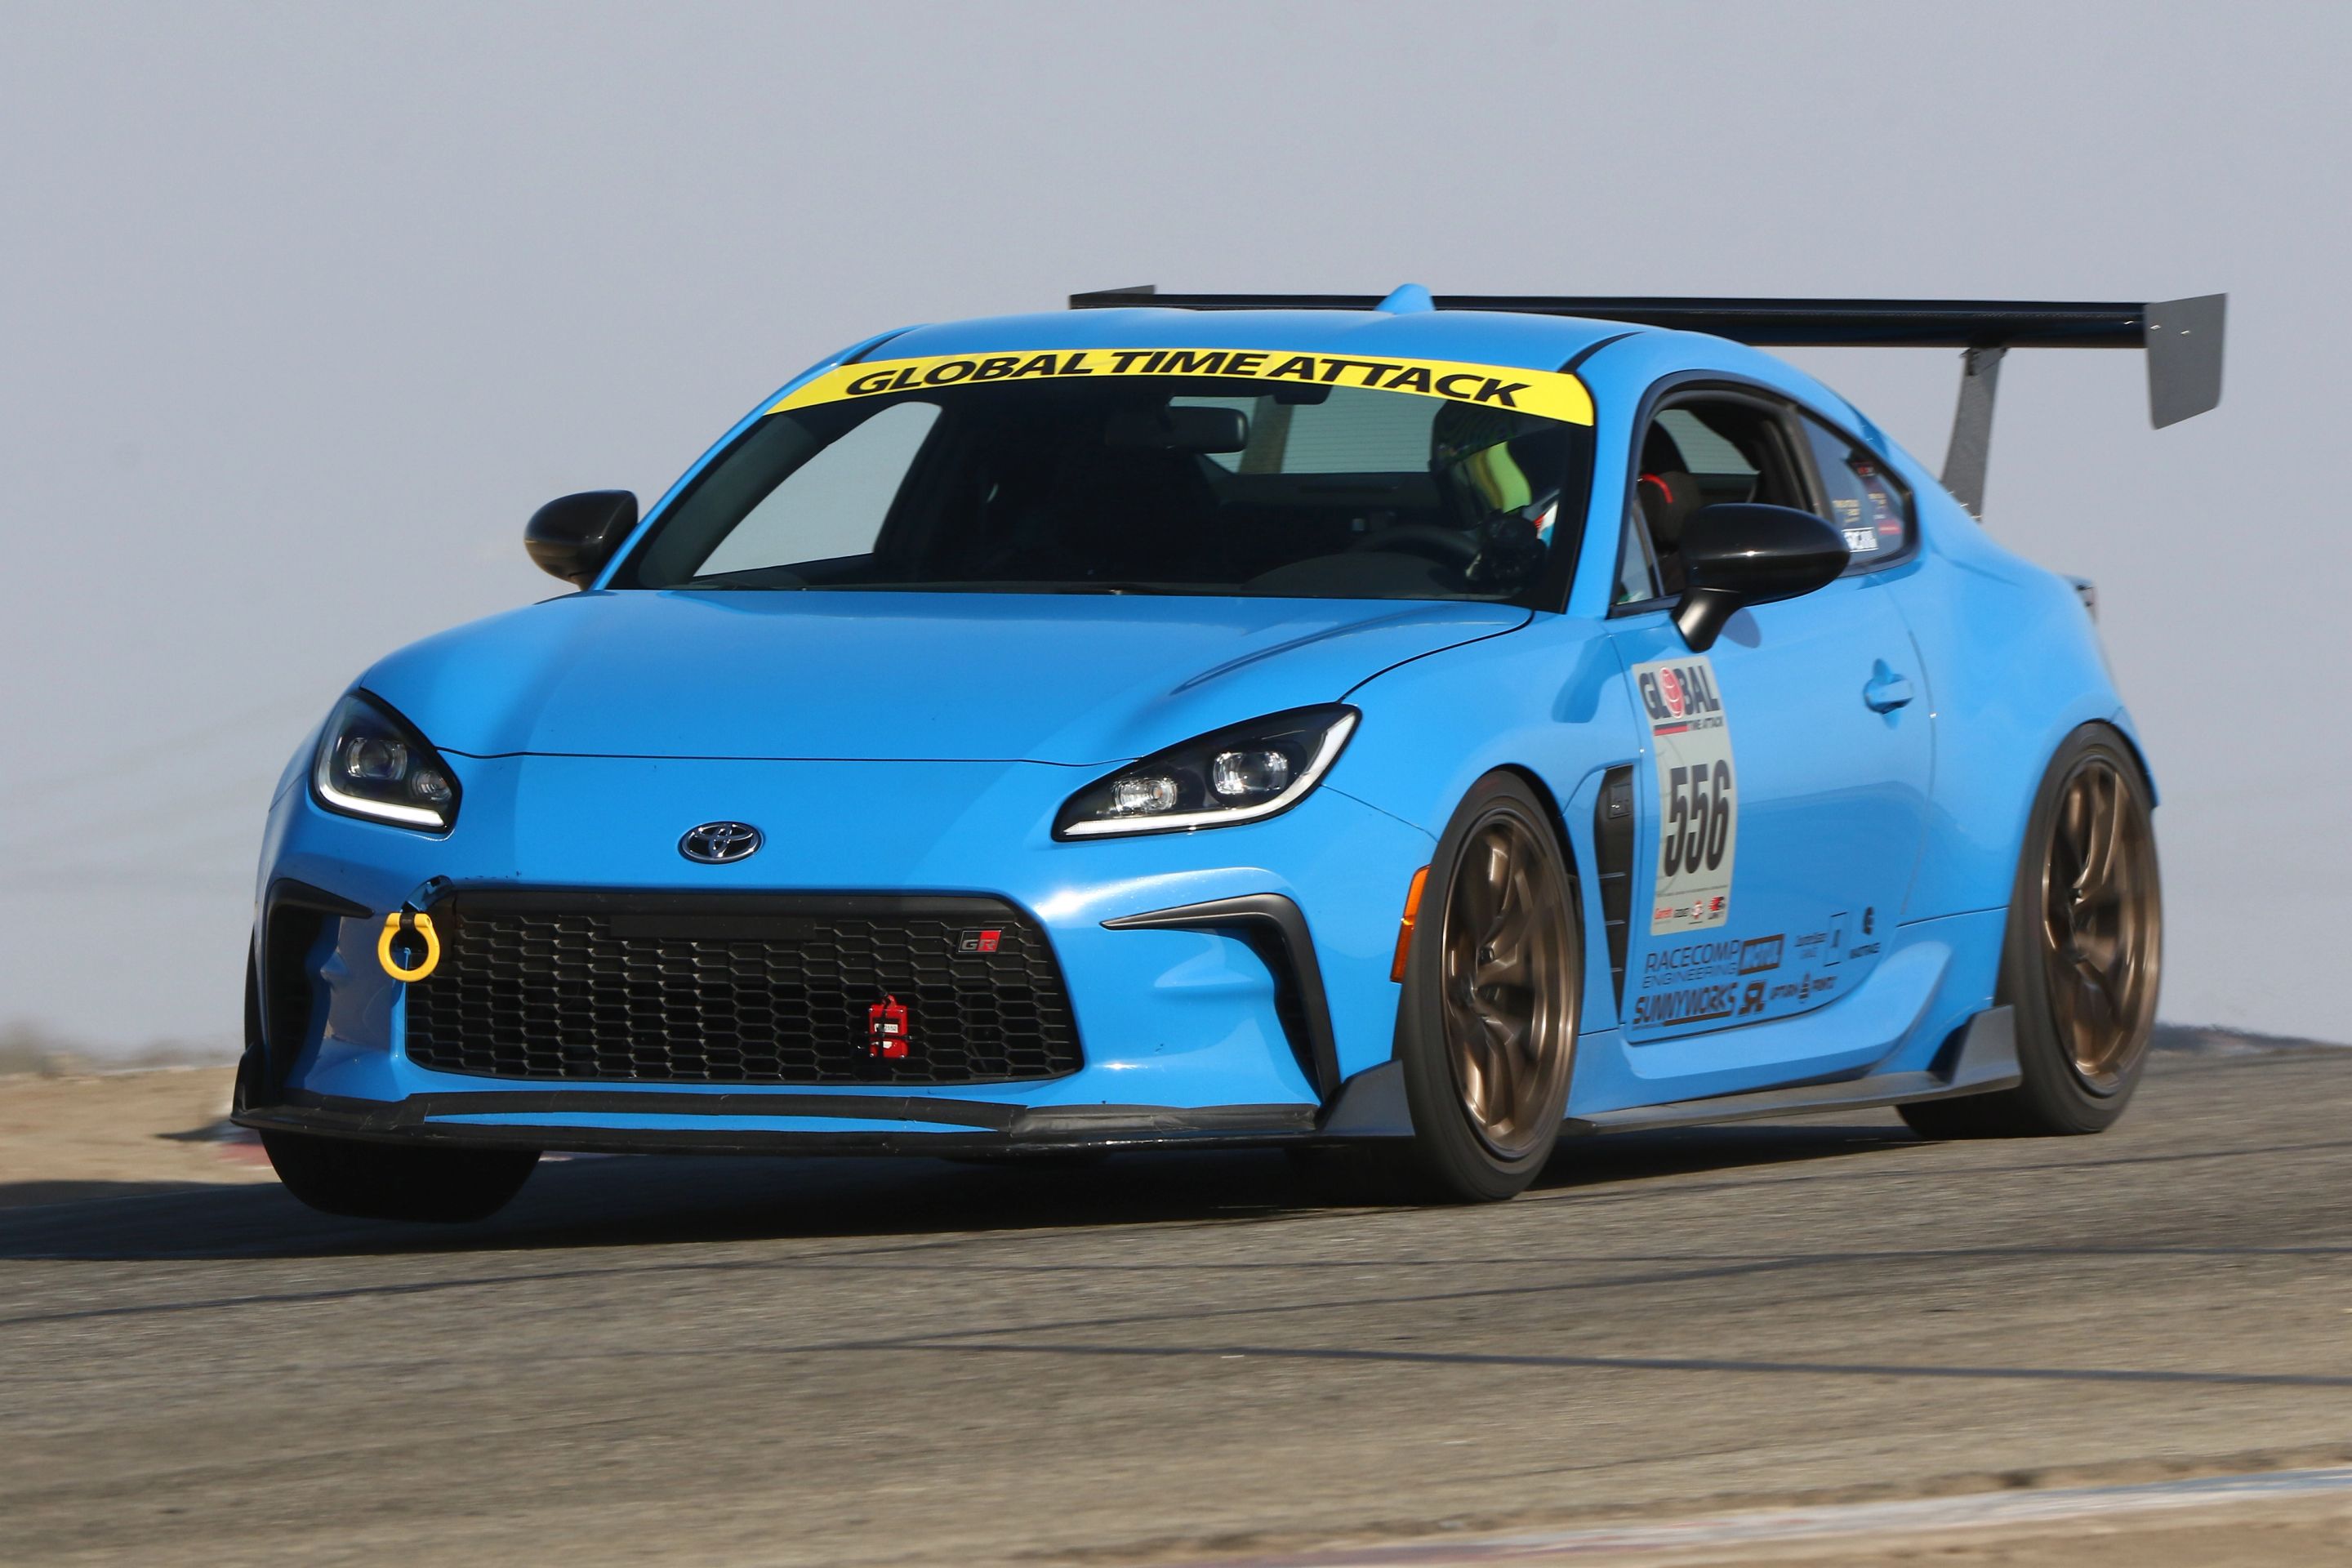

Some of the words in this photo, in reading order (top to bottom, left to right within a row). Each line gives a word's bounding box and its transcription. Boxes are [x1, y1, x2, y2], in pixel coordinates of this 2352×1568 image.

[845, 352, 1094, 395] GLOBAL
[1111, 350, 1272, 375] TIME
[1265, 355, 1532, 408] ATTACK
[1638, 666, 1721, 719] GLOBAL
[1664, 759, 1731, 877] 556
[961, 938, 997, 951] GR
[1645, 939, 1740, 973] RACECOMP
[1642, 962, 1739, 989] ENGINEERING
[1633, 982, 1739, 1025] SUNNYWORKS
